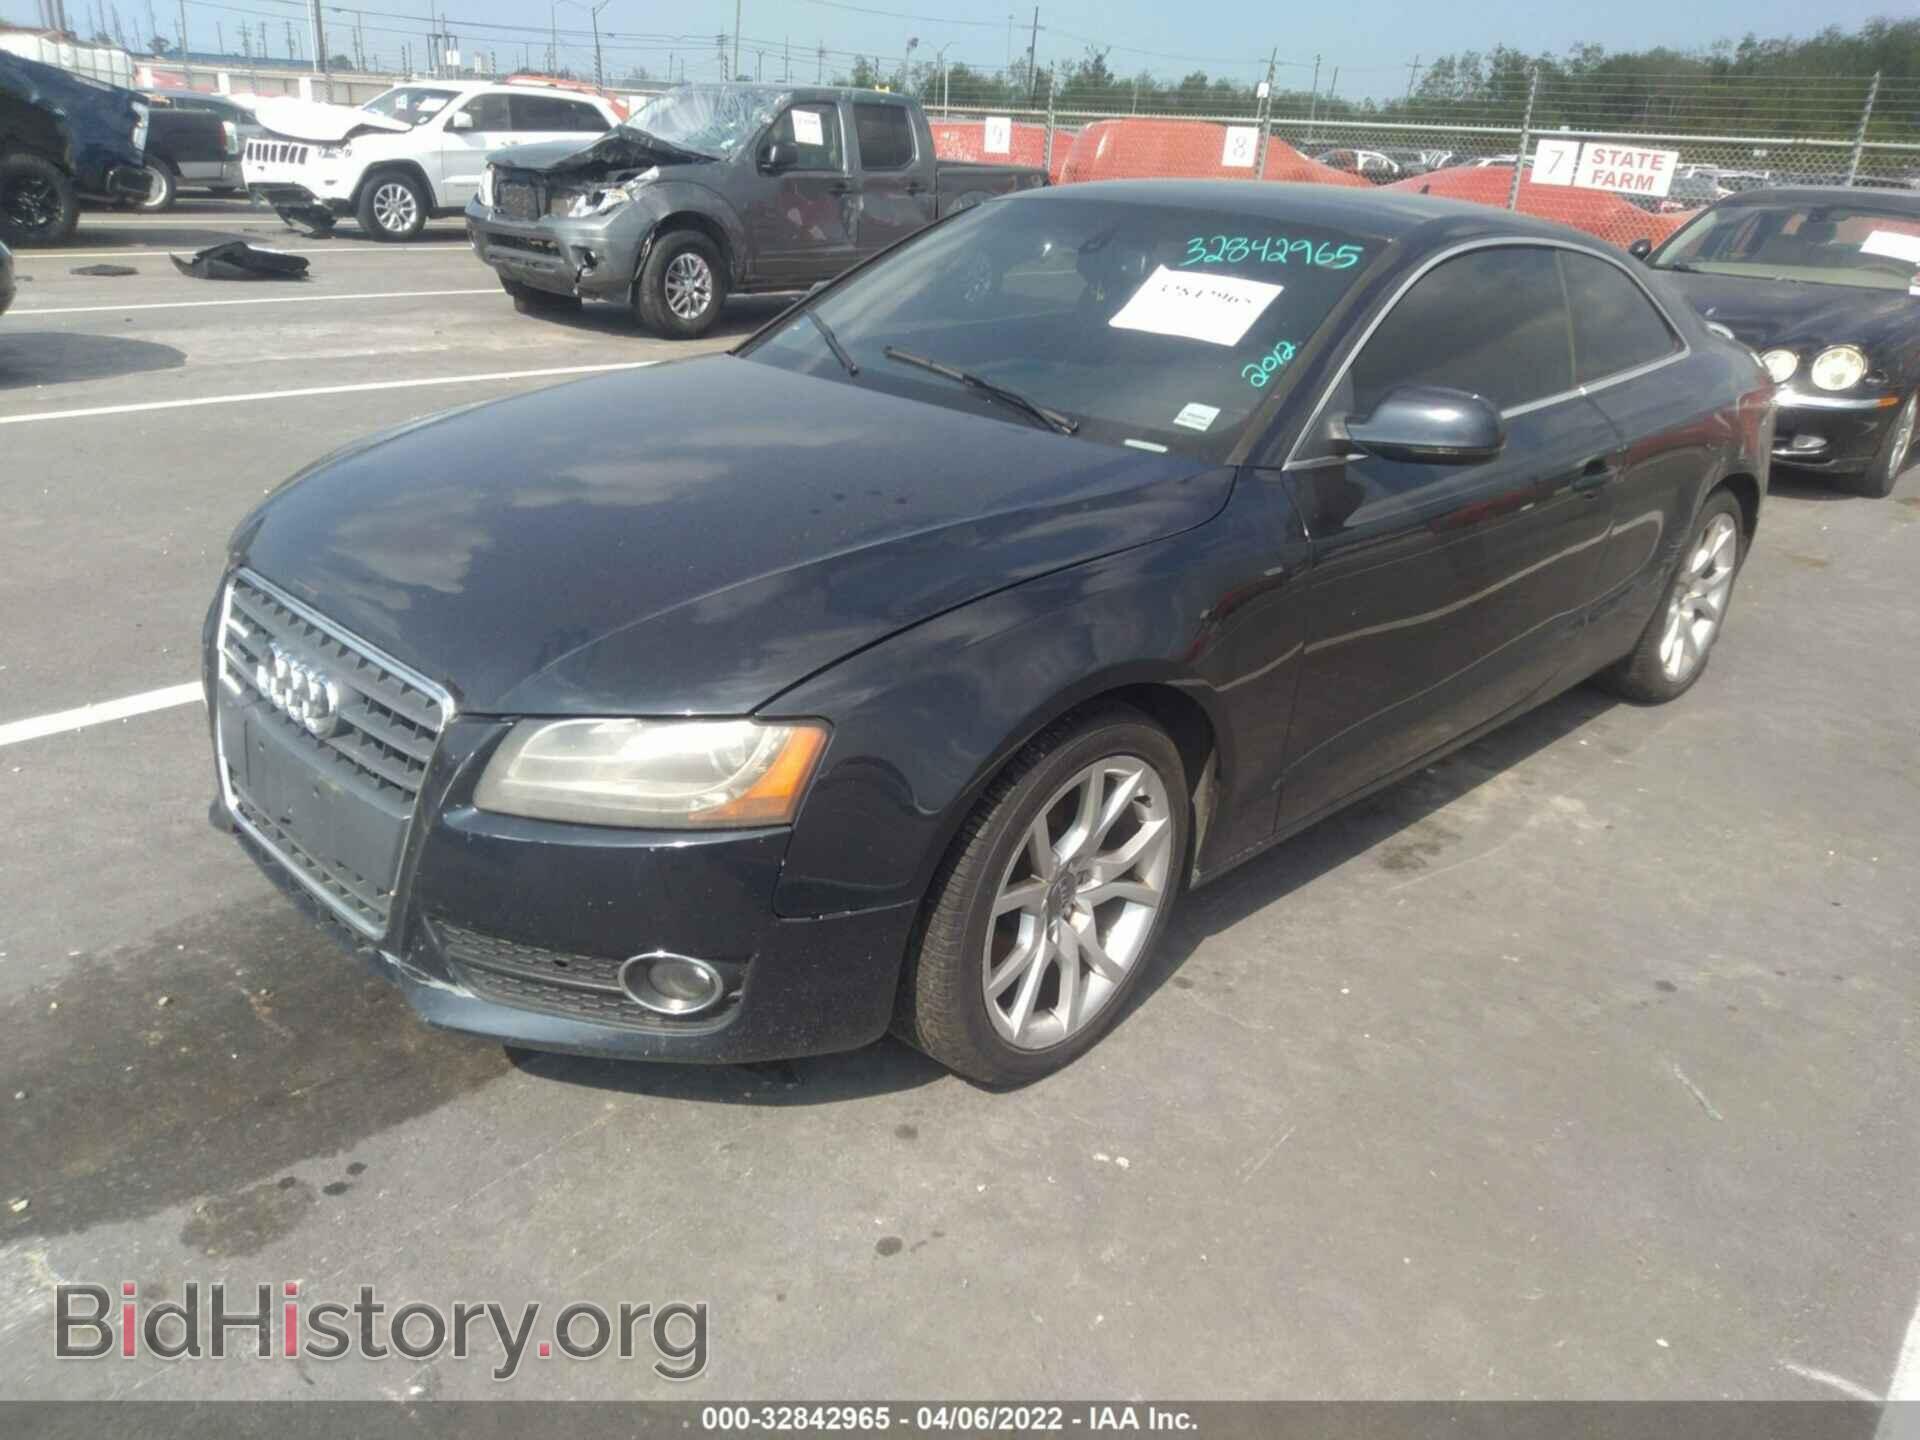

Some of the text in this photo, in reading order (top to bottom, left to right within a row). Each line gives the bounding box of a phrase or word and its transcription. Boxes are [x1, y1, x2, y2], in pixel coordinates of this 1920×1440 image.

[1546, 149, 1565, 175] 7
[1591, 148, 1666, 171] STATE
[1590, 170, 1656, 191] FARM
[1179, 235, 1364, 270] 32842965
[1241, 340, 1297, 388] 2012
